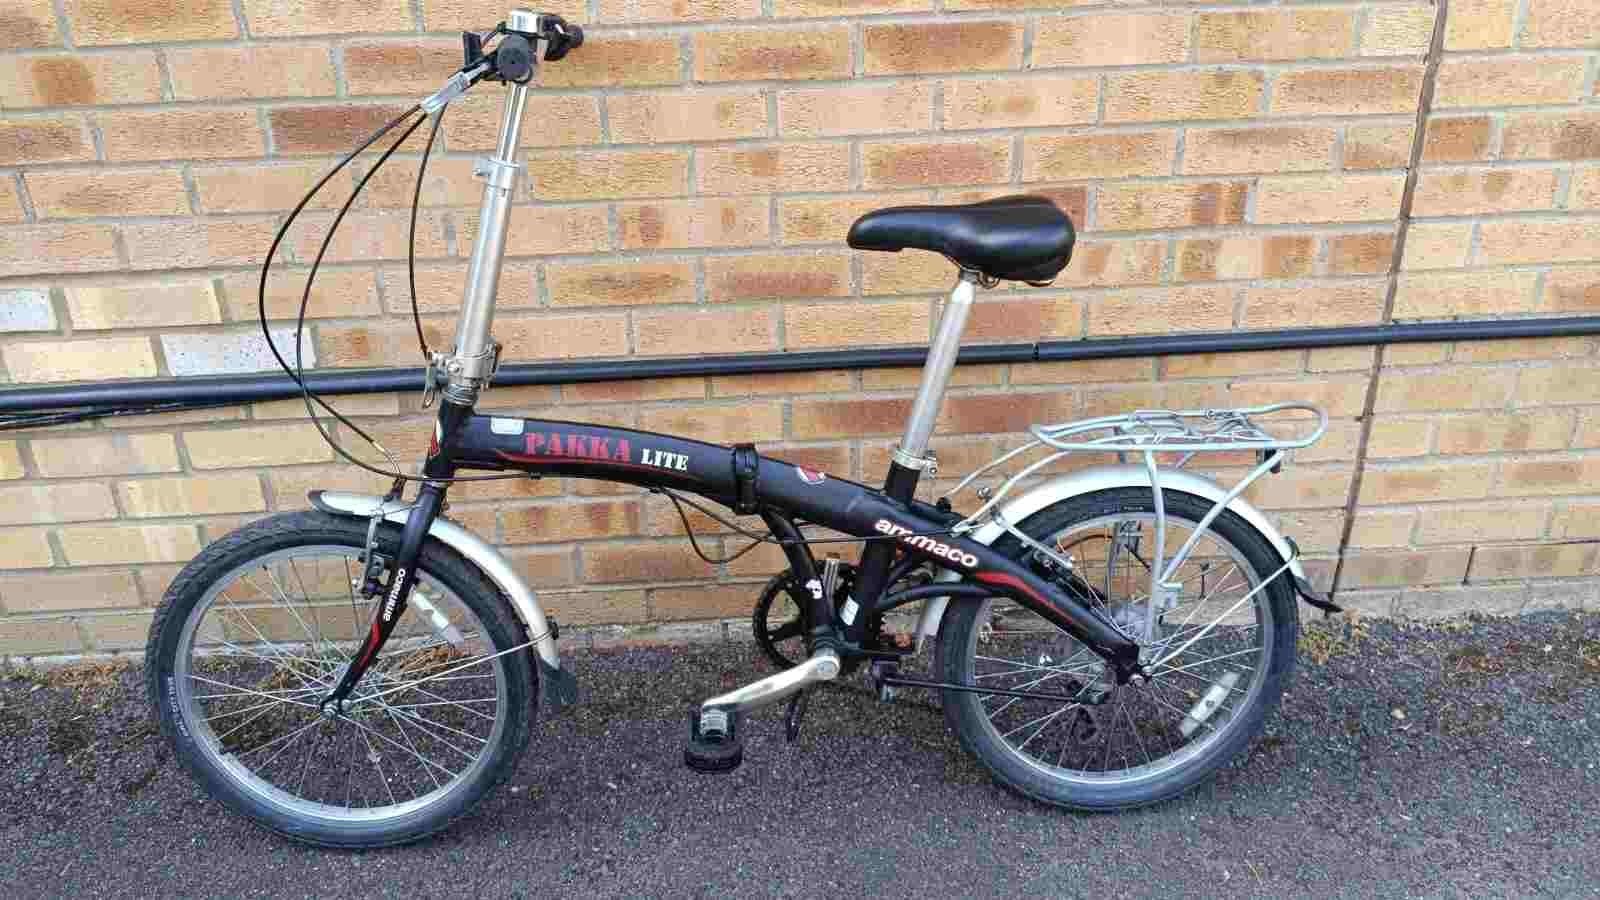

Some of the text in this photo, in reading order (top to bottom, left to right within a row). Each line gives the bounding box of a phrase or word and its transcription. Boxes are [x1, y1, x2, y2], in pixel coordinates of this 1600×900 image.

[523, 432, 689, 472] PAKKA LITE
[383, 568, 406, 622] ammaco
